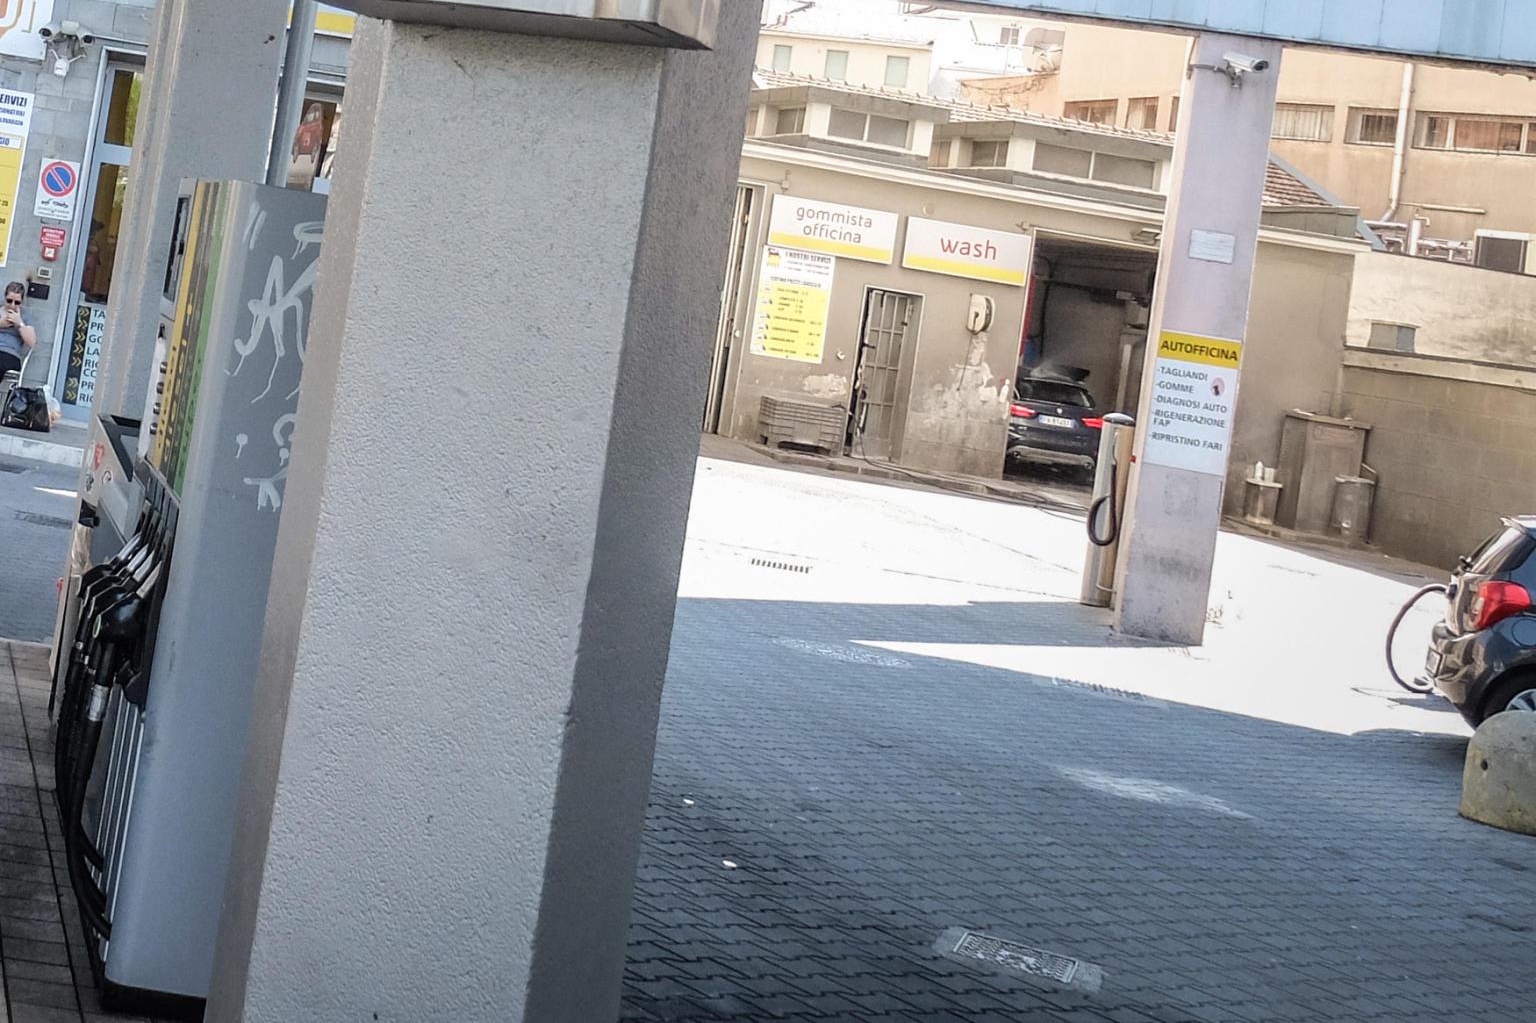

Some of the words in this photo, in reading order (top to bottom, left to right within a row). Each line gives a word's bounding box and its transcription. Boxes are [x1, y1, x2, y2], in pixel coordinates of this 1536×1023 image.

[796, 207, 872, 228] gommista
[803, 223, 862, 243] officina
[940, 237, 997, 261] wash
[1160, 340, 1238, 361] AUTOFFICINA
[1202, 402, 1228, 414] AUTO
[1202, 440, 1223, 451] FARI
